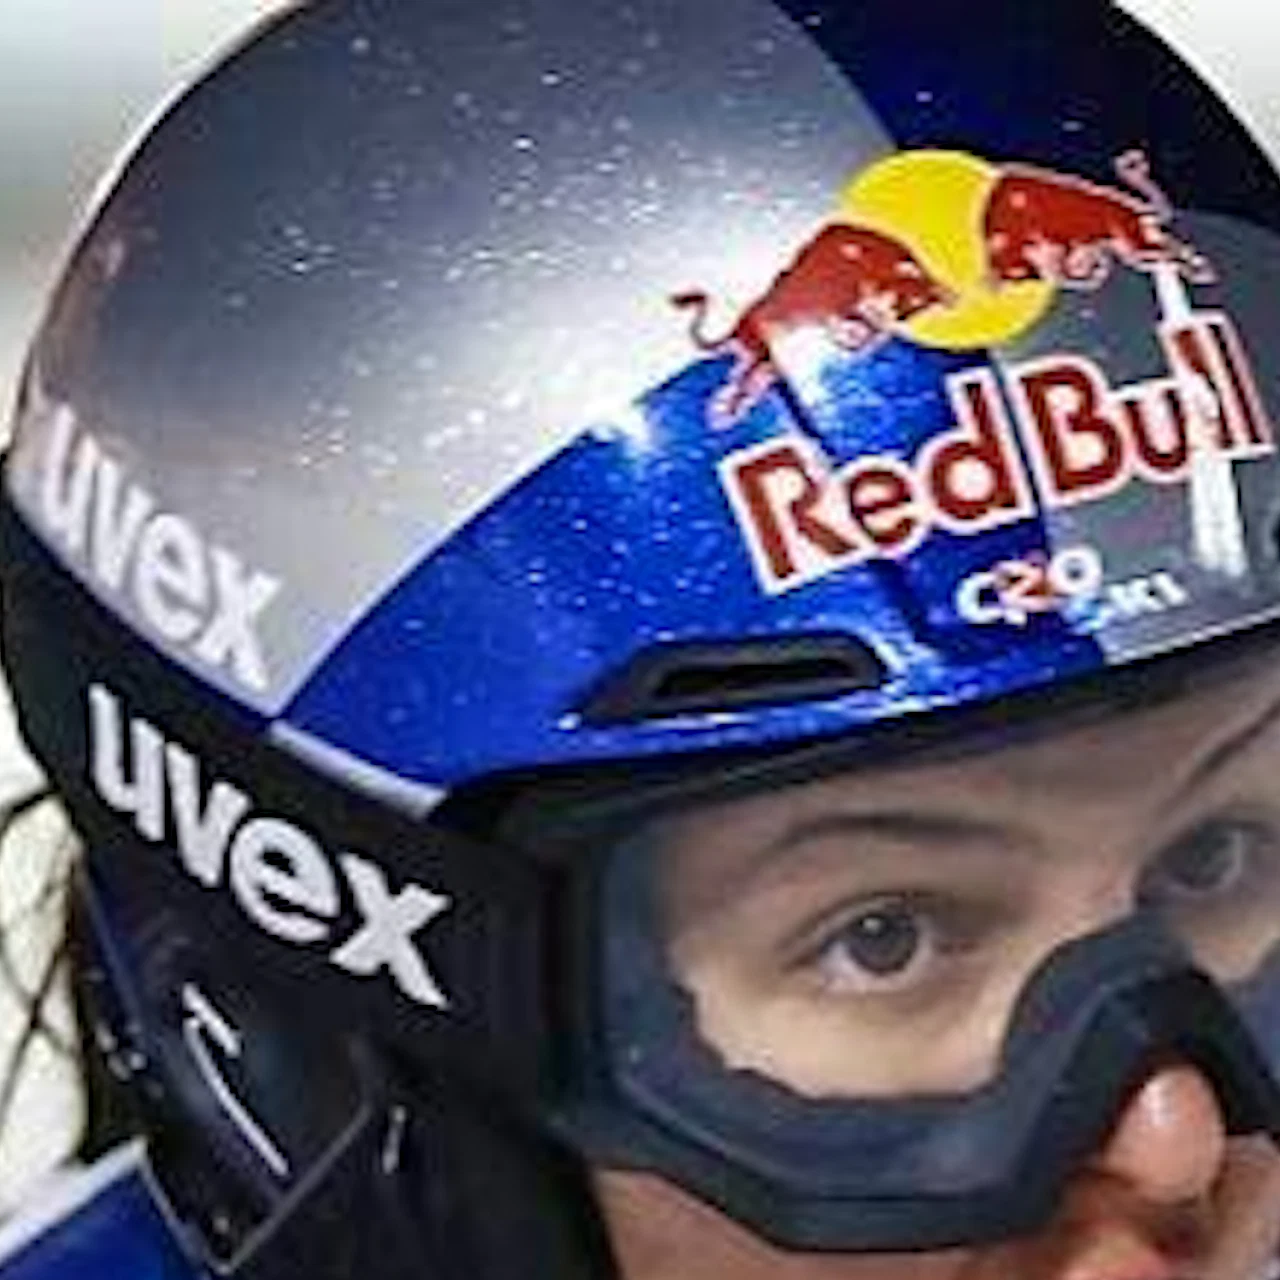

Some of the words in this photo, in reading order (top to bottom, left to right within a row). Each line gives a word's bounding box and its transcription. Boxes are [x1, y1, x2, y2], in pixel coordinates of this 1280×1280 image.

[36, 402, 283, 692] uvex
[722, 360, 1033, 594] Red
[1004, 313, 1275, 505] Bull
[88, 682, 451, 1008] uvex
